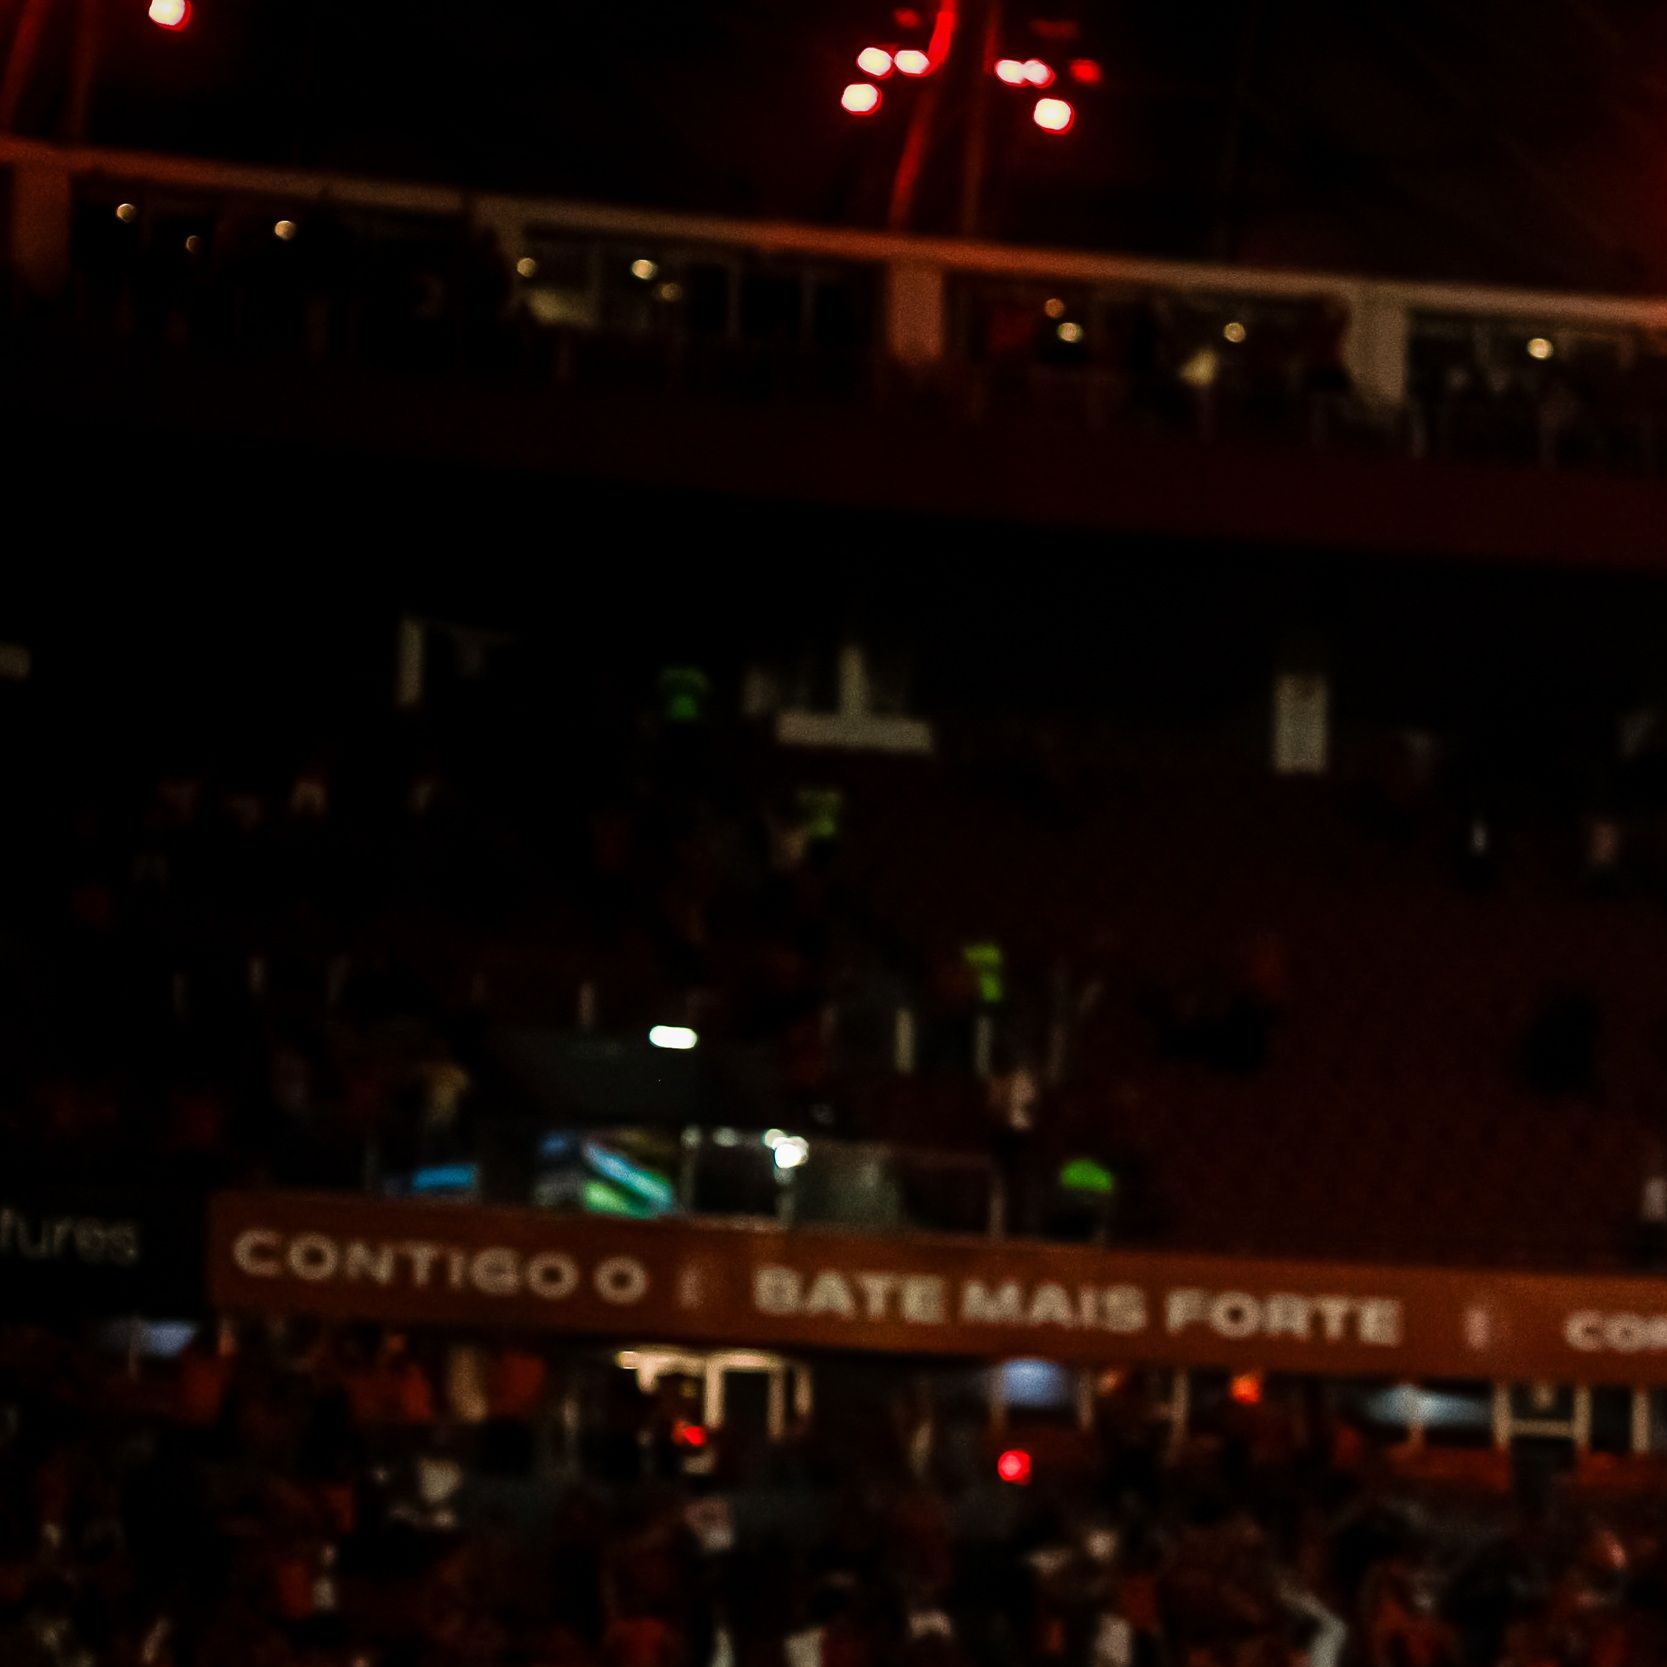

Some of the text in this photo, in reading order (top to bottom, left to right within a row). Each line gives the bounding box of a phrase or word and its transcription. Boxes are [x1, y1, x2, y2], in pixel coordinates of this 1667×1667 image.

[232, 1229, 647, 1305] CONTIGO O
[751, 1266, 1402, 1347] BATE MAIS FORTE
